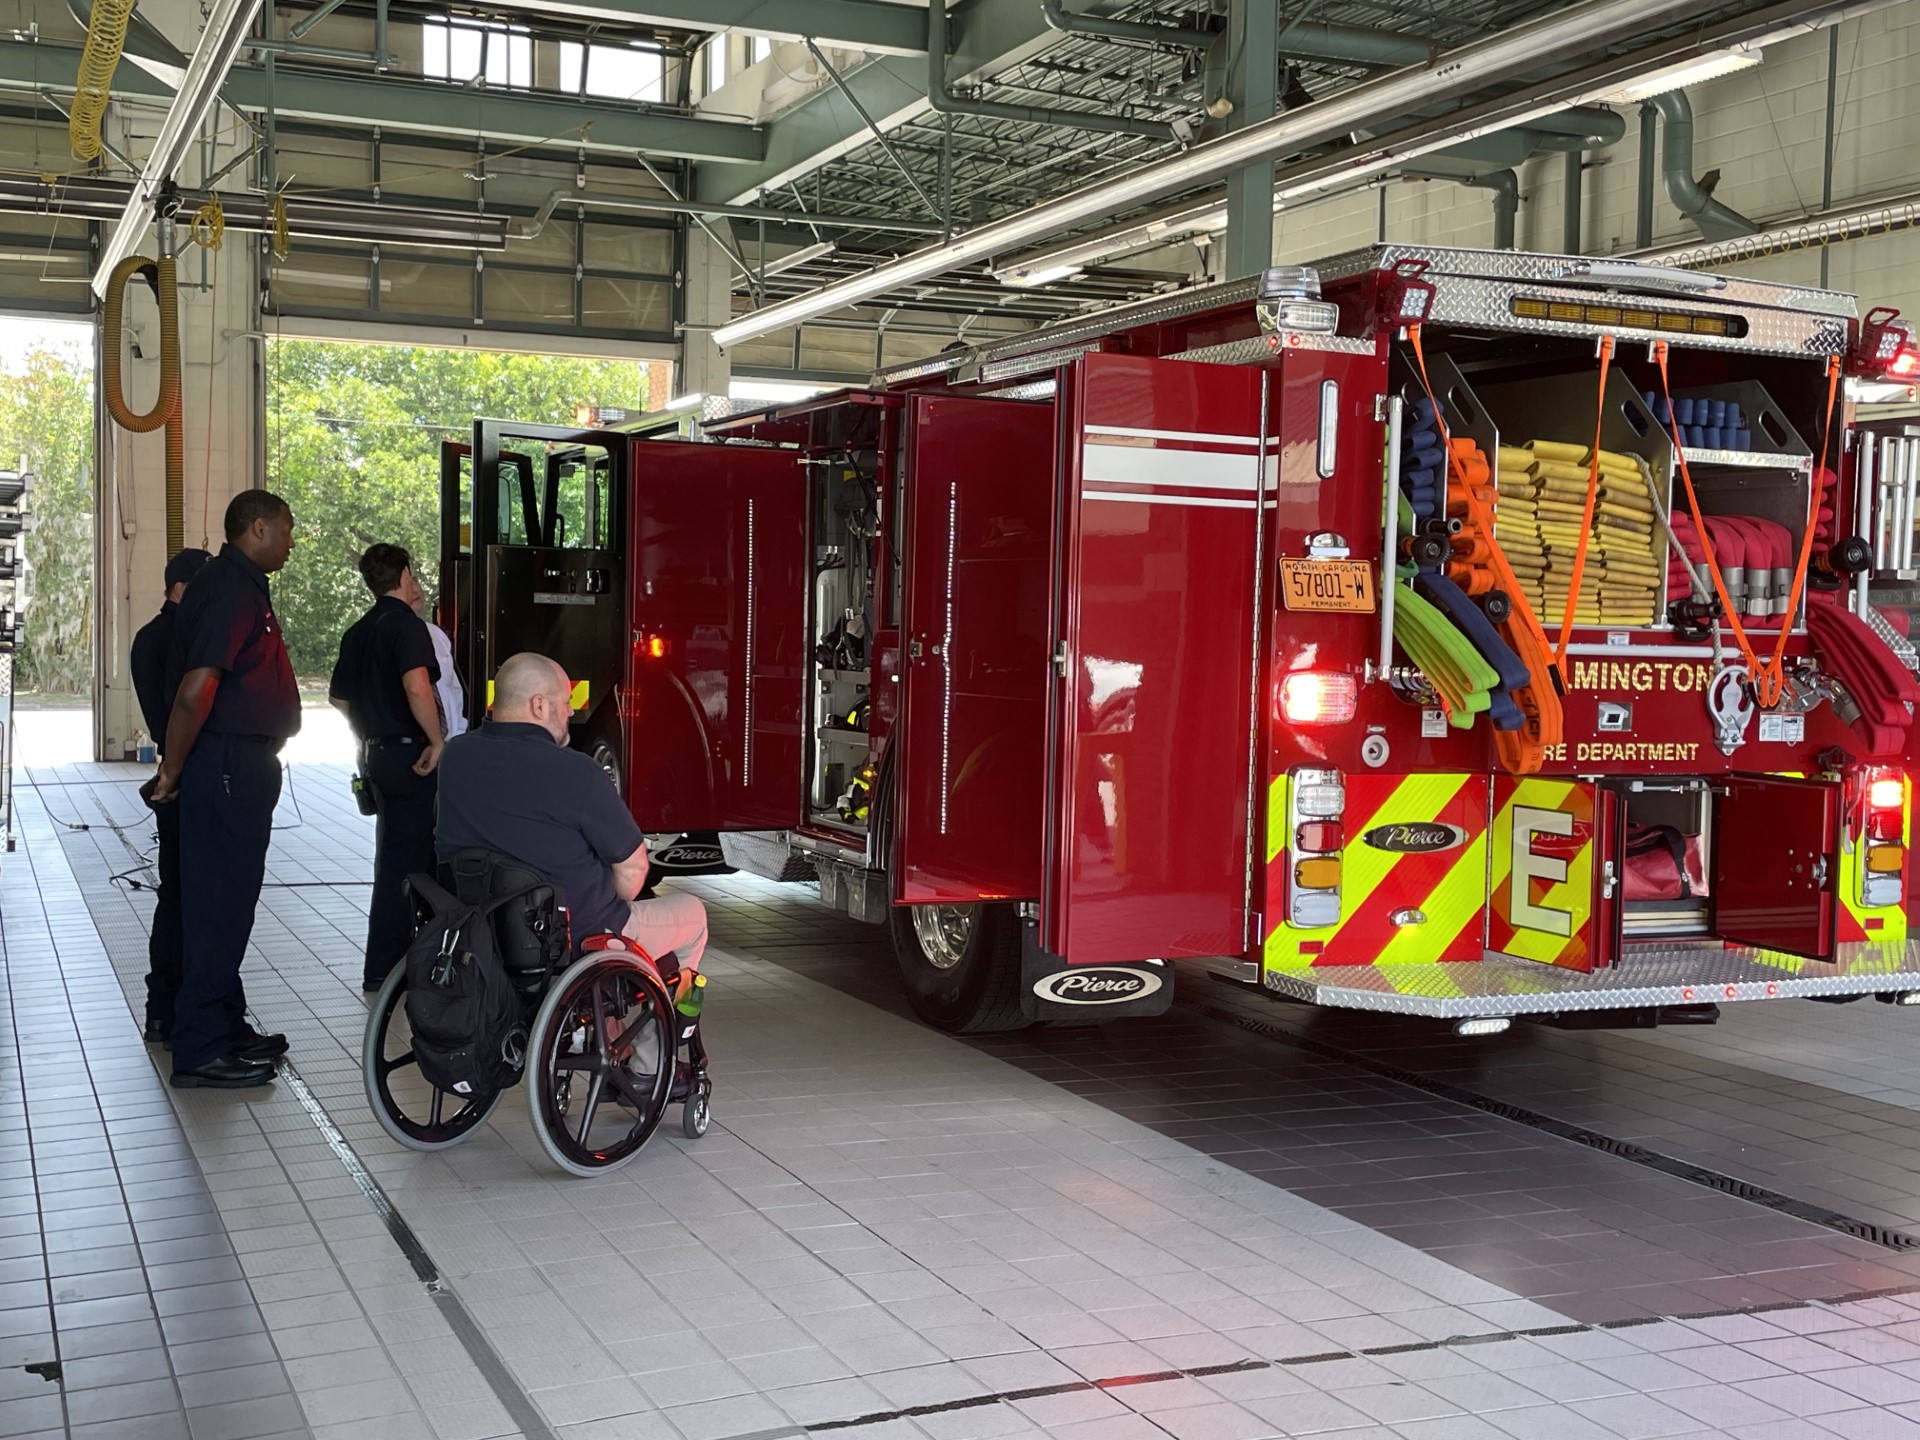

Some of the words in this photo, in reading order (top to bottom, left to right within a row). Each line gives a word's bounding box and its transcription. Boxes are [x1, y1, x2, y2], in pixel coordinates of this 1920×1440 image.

[1285, 562, 1318, 572] NORTH
[1322, 563, 1367, 574] CAROLINA
[1292, 572, 1365, 599] 57801-W
[1310, 600, 1352, 608] PERMANENT
[1567, 661, 1715, 692] MINGTON
[1577, 743, 1700, 761] DEPARTMENT
[1385, 826, 1446, 847] Pierce
[663, 848, 720, 862] Pierce
[1511, 804, 1575, 939] E
[1056, 976, 1140, 996] Pierce
